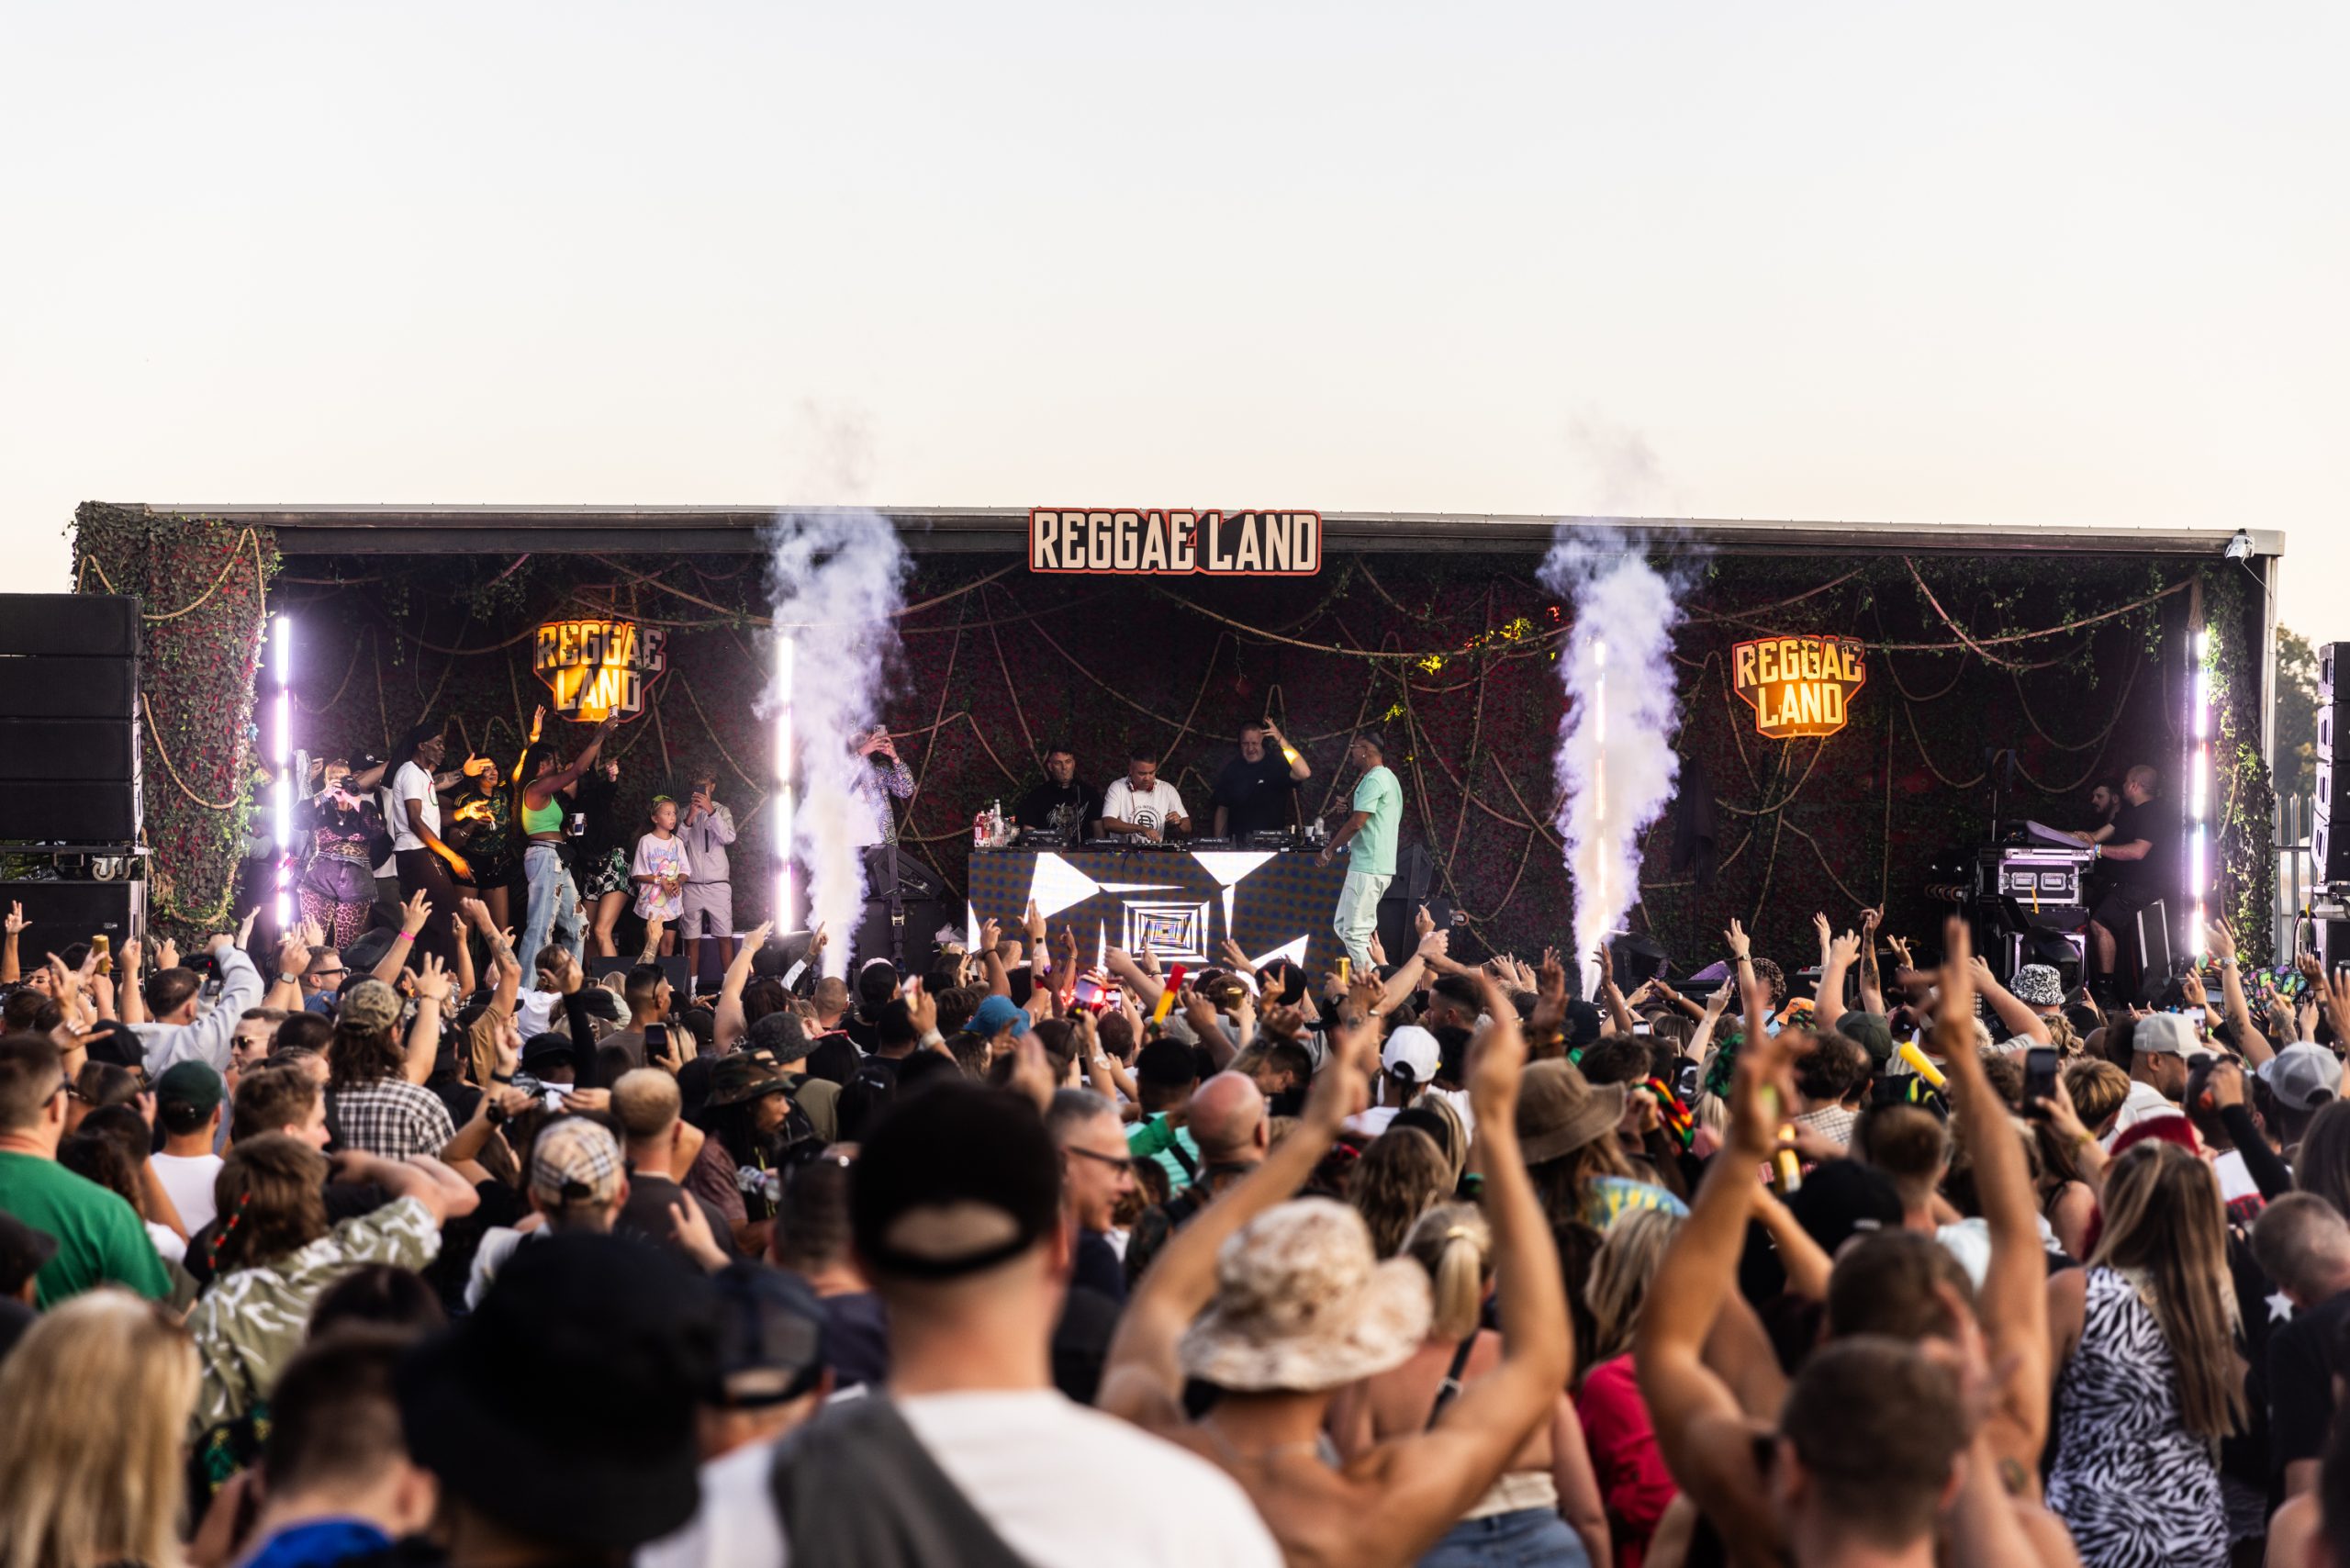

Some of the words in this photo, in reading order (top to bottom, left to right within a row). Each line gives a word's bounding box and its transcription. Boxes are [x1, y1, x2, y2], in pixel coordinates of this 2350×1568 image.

[1034, 511, 1194, 570] REGGAE
[1209, 513, 1316, 571] LAND
[537, 623, 663, 671] REGGAE
[1736, 639, 1863, 689] REGGAE
[556, 667, 641, 711] LAND
[1758, 682, 1843, 728] LAND
